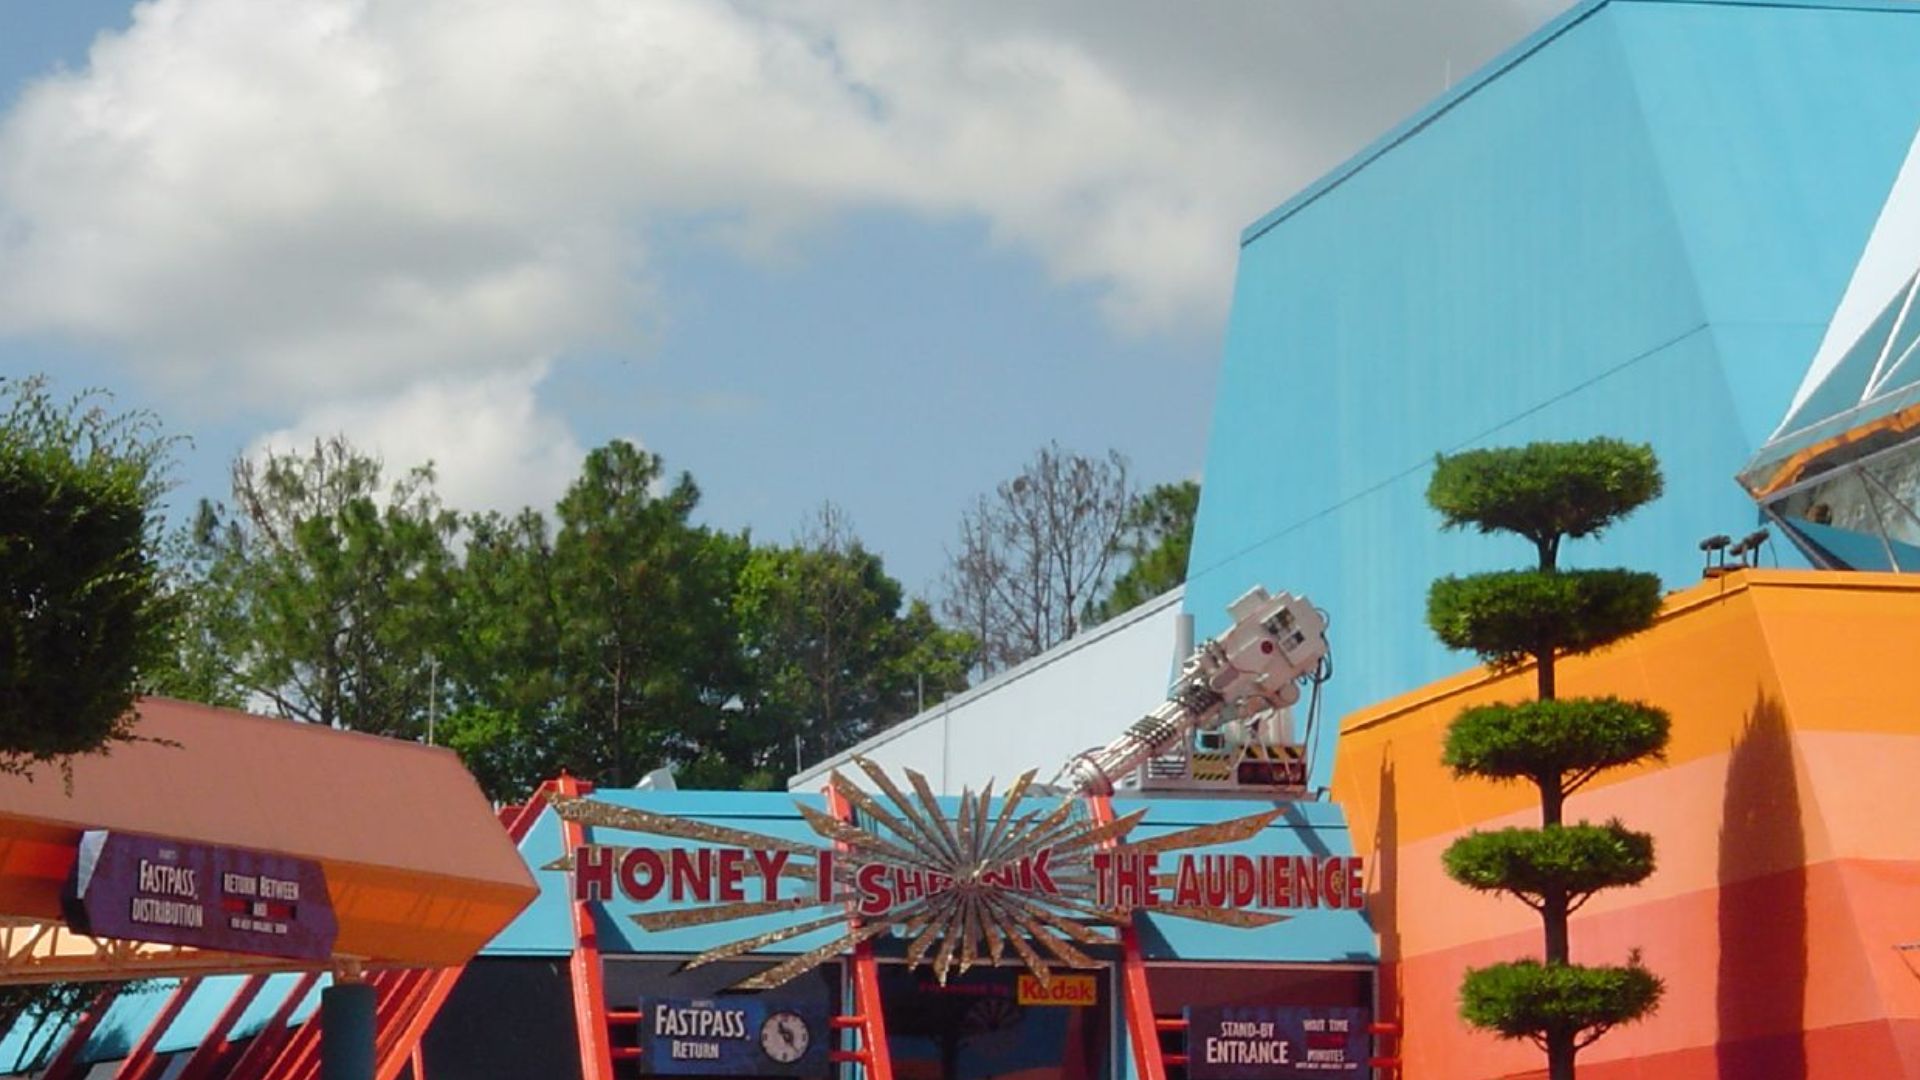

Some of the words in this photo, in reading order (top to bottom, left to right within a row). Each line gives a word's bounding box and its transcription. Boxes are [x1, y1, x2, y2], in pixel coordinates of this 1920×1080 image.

[224, 873, 257, 895] RETURN
[260, 875, 299, 900] BETWEEN
[818, 849, 835, 905] I
[857, 847, 1059, 916] SHRNK
[1092, 853, 1159, 908] THE
[1175, 853, 1364, 909] AUDIENCE
[132, 897, 203, 928] DISTRIBUTION
[1023, 979, 1093, 999] Kodak
[1221, 1021, 1275, 1039] STAND-BY
[1328, 1019, 1349, 1032] TIME
[672, 1039, 720, 1060] RETURN
[1206, 1037, 1290, 1065] ENTRANCE
